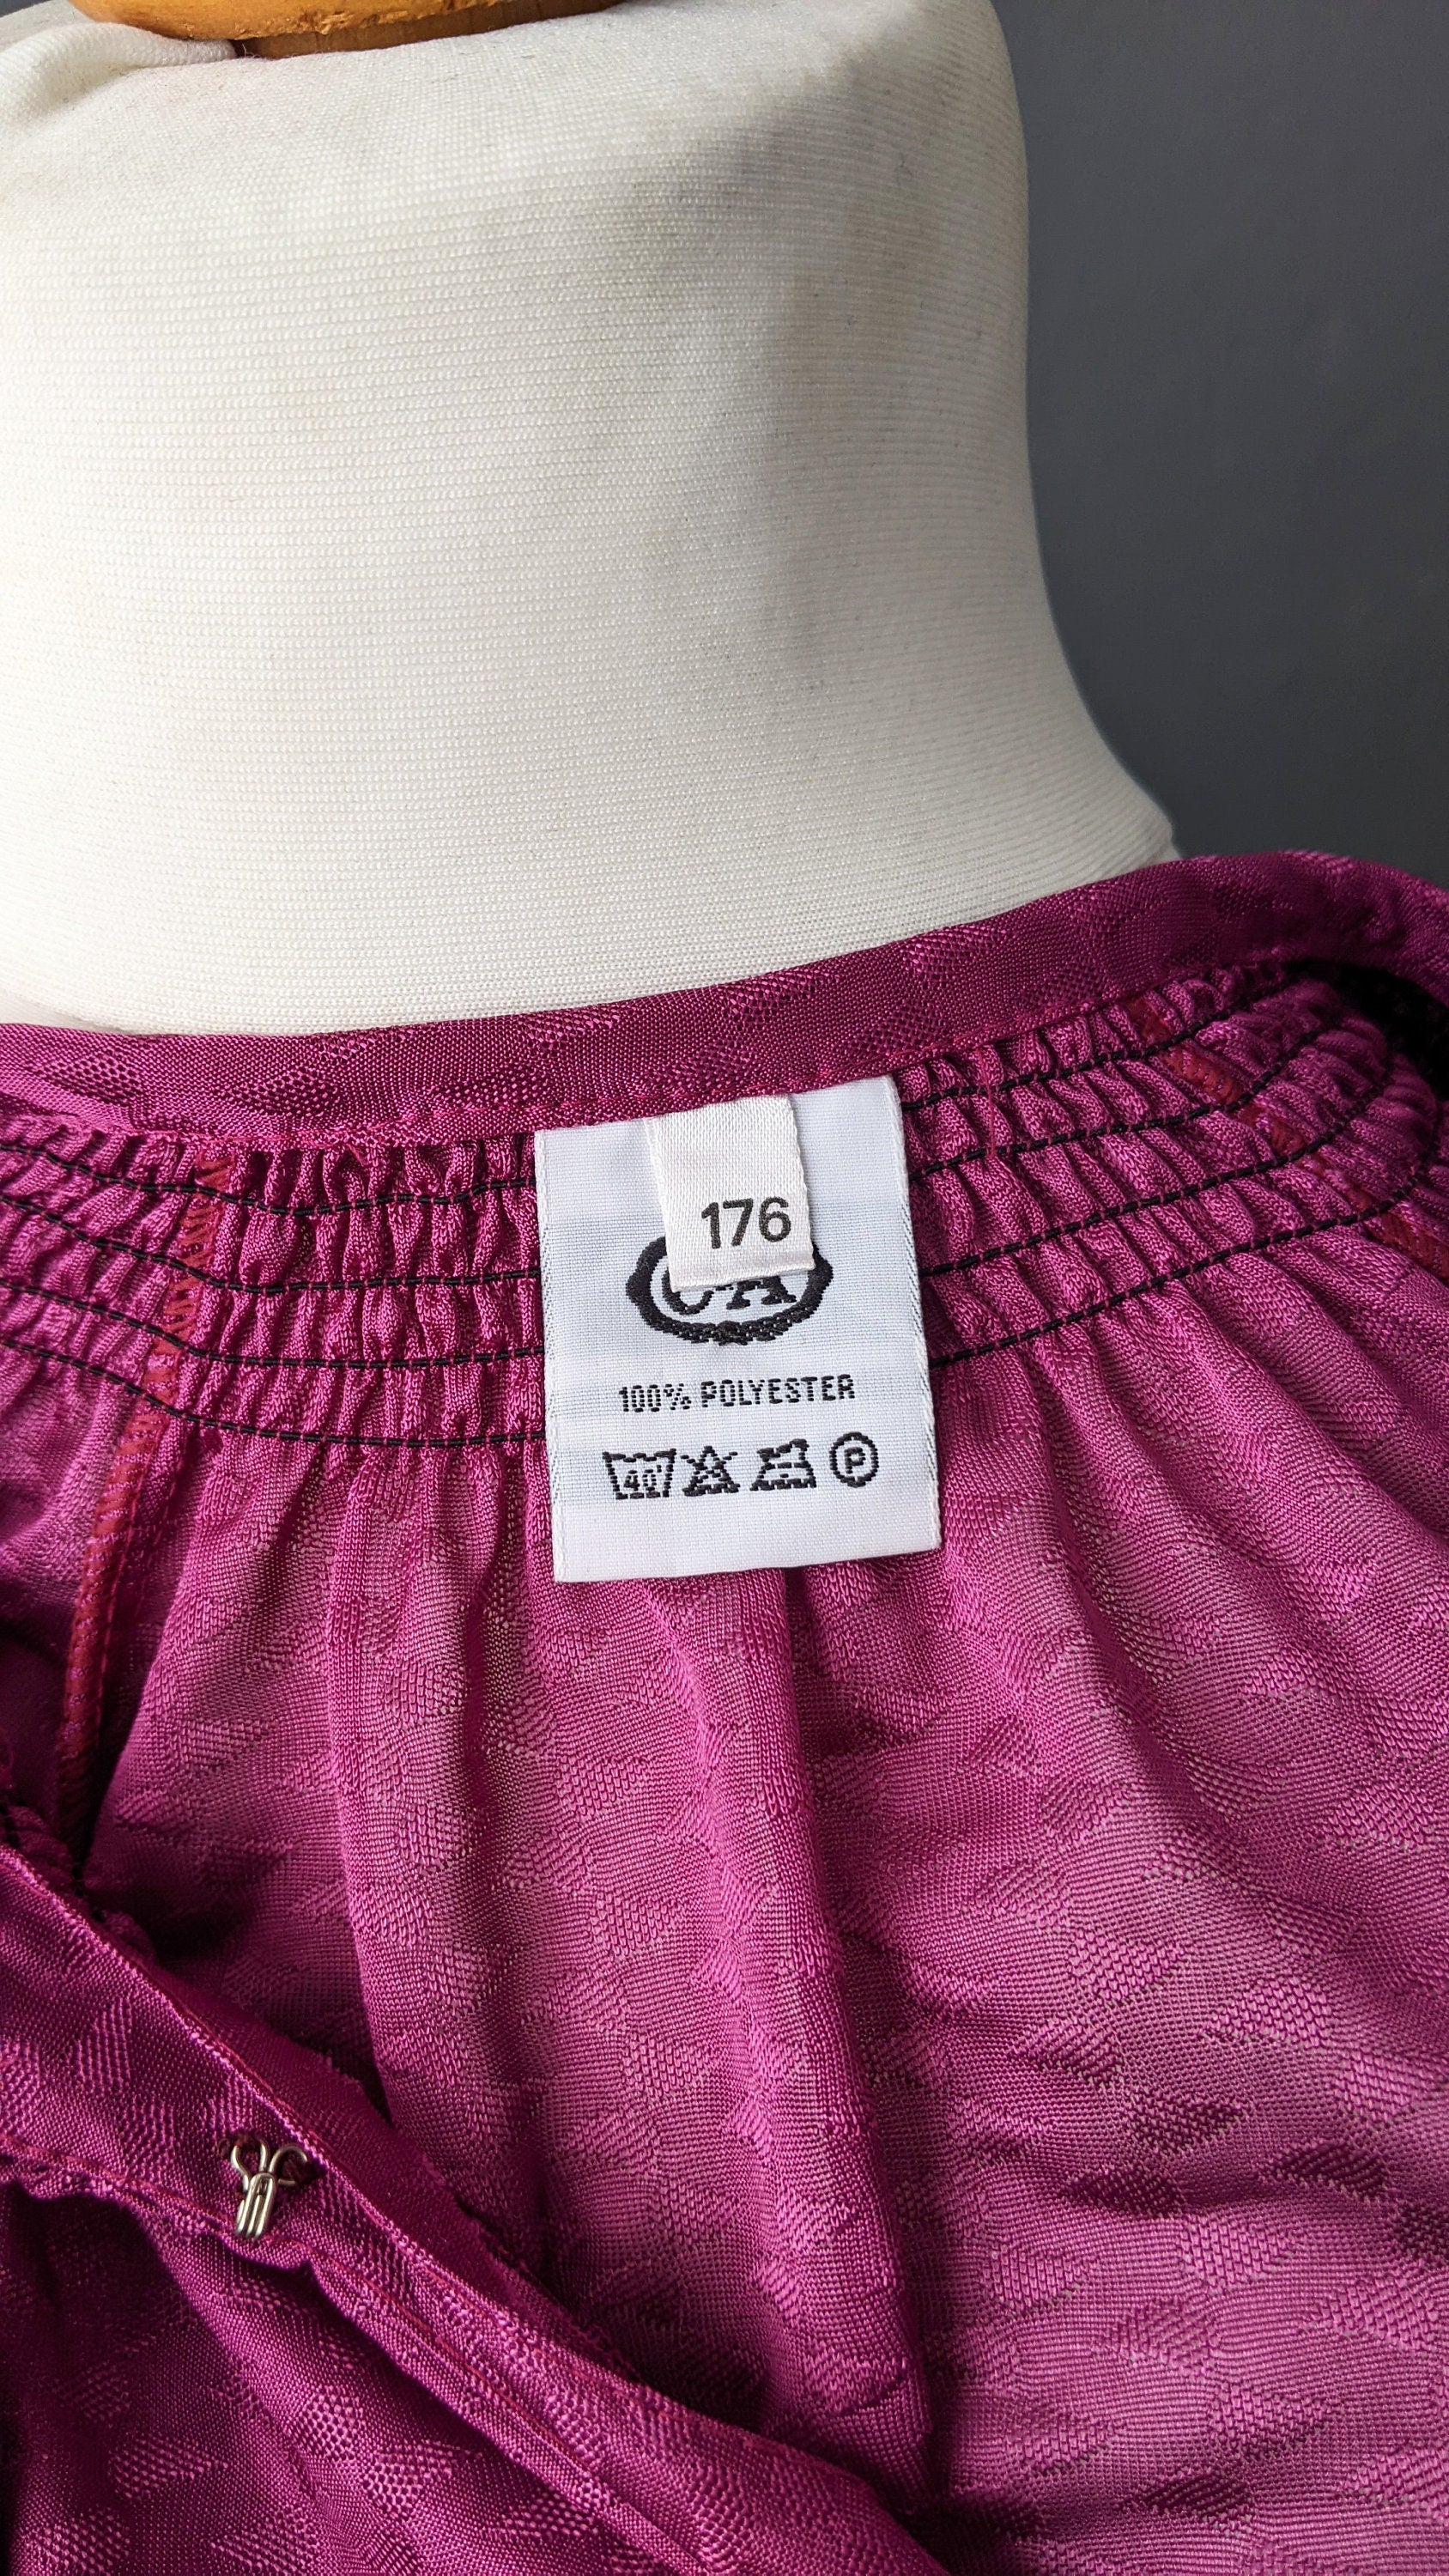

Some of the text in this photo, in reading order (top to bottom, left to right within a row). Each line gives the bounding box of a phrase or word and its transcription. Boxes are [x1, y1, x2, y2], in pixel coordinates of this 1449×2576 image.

[701, 1196, 791, 1249] 176
[619, 1374, 856, 1413] 100% POLYESTER
